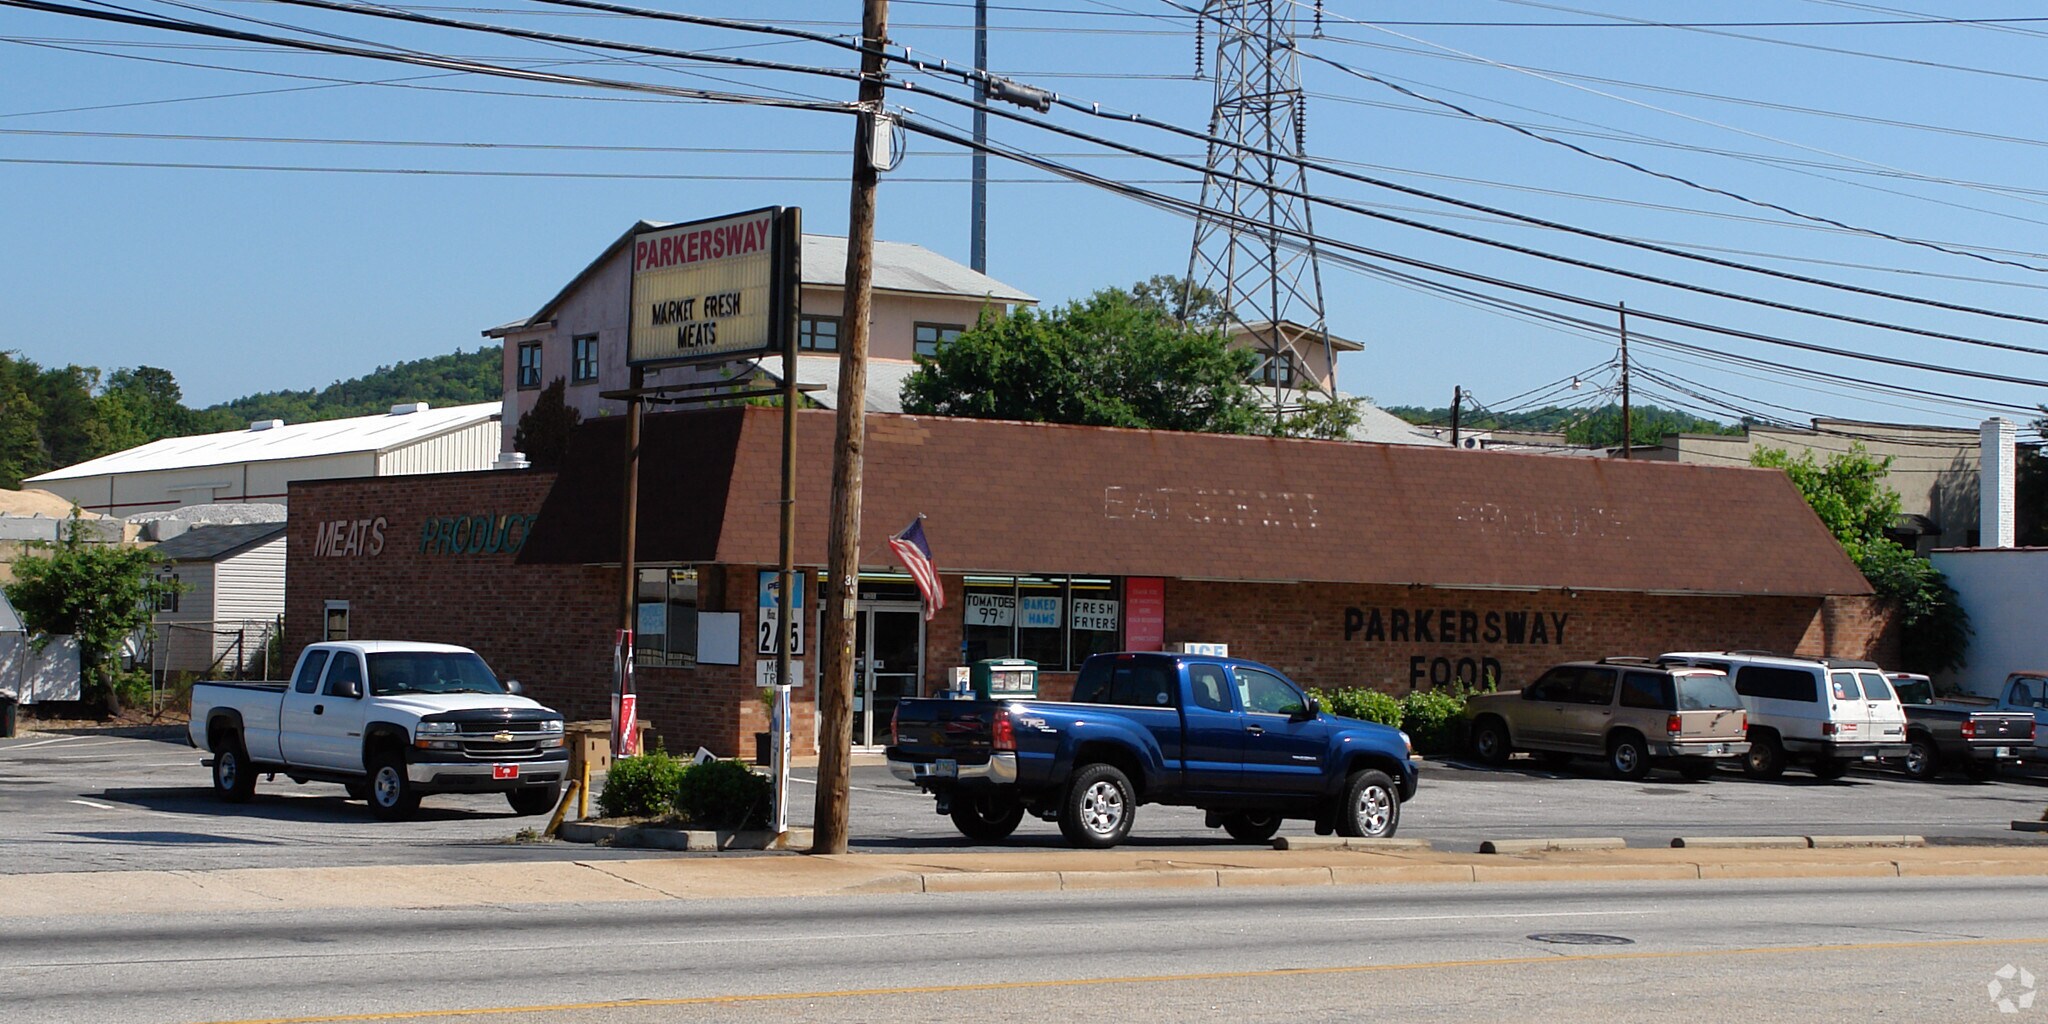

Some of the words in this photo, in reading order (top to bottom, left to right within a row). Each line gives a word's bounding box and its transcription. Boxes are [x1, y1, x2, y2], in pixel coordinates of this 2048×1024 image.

[636, 218, 769, 271] PARKERSWAY
[652, 299, 695, 325] MARKET
[704, 292, 741, 317] FRESH
[677, 322, 716, 349] MEATS
[314, 516, 387, 557] MEATS
[967, 595, 1016, 609] TOMATOES
[1023, 598, 1057, 610] BAKED
[1074, 602, 1114, 616] FRESH
[1028, 613, 1055, 625] HAMS
[1074, 616, 1116, 630] FRYERS
[1344, 607, 1569, 645] PARKERSWAY
[1189, 645, 1224, 655] ICE
[1409, 655, 1502, 691] FOOD
